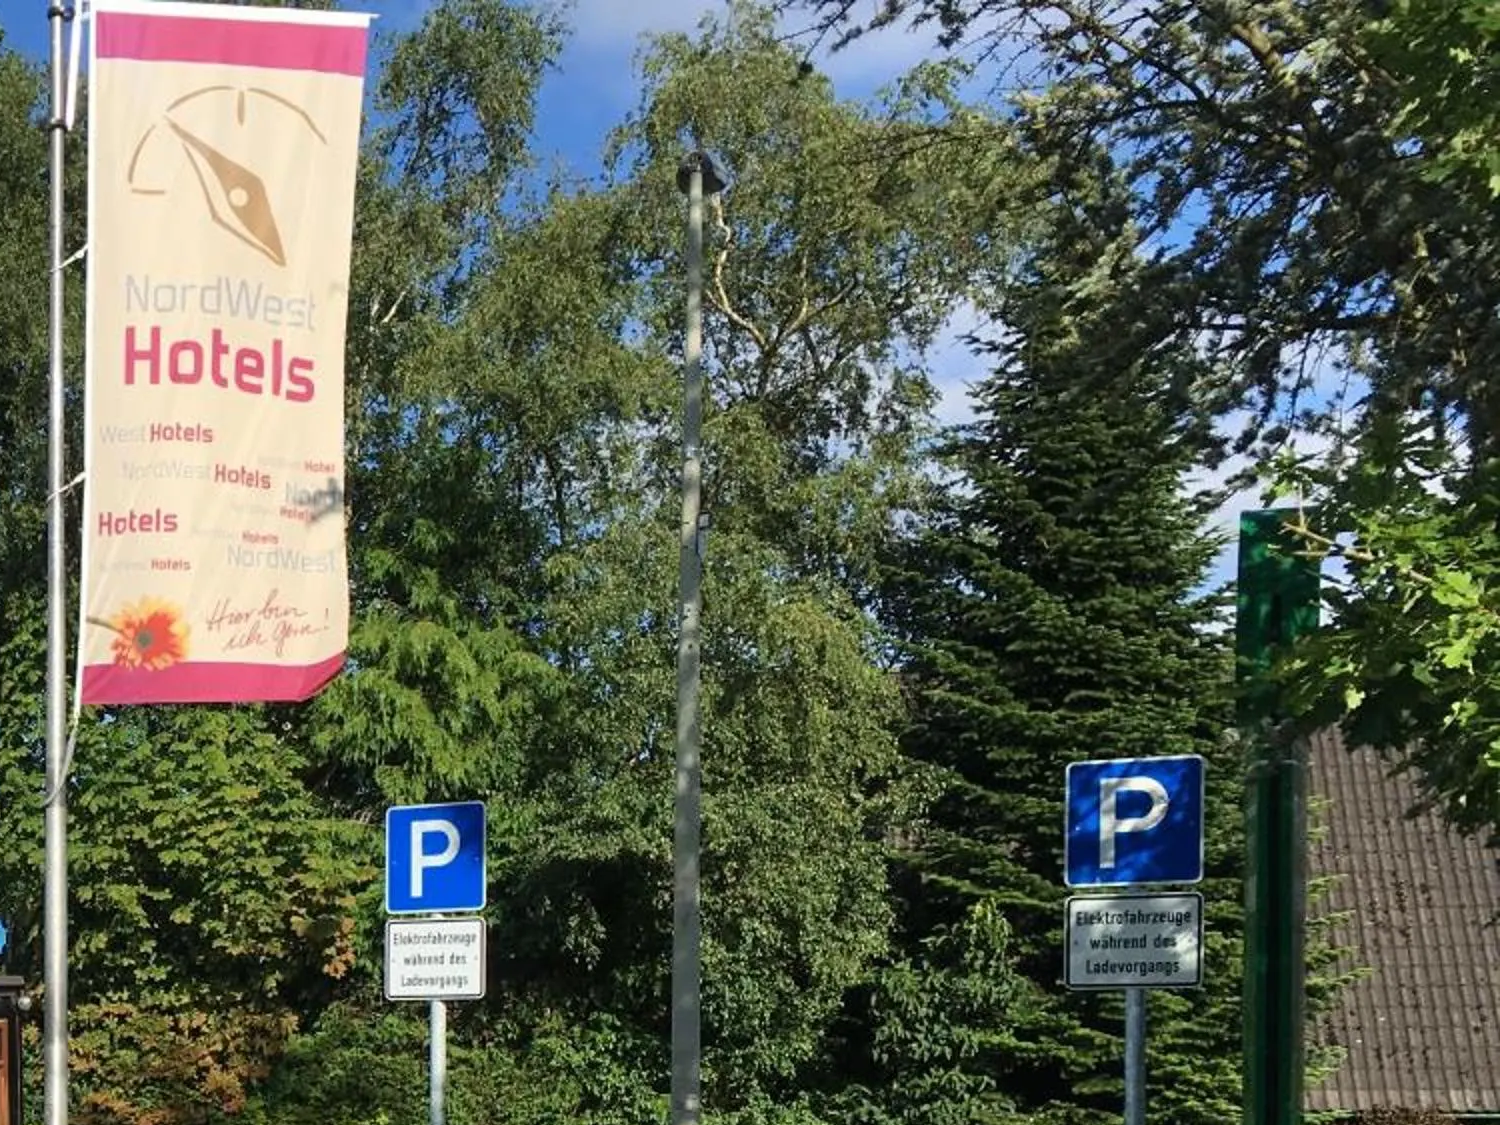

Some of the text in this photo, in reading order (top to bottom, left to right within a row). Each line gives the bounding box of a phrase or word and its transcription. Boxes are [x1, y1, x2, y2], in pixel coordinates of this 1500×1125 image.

[124, 274, 316, 331] NordWest
[123, 325, 315, 403] Hotels
[149, 423, 213, 444] Hotels
[214, 463, 271, 490] Hotels
[98, 508, 178, 537] Hotels
[243, 530, 279, 545] Hotels
[150, 557, 191, 571] Hotels
[227, 546, 336, 574] NordWest
[1100, 776, 1168, 869] P
[410, 819, 461, 898] P
[1076, 910, 1192, 928] Elektrofahrzeuge
[393, 931, 477, 948] Elektrofahrzeuge
[1090, 933, 1177, 949] während des
[403, 952, 468, 966] während des
[1086, 959, 1181, 977] Ladevorgangs
[400, 973, 469, 989] Ladevorgangs
